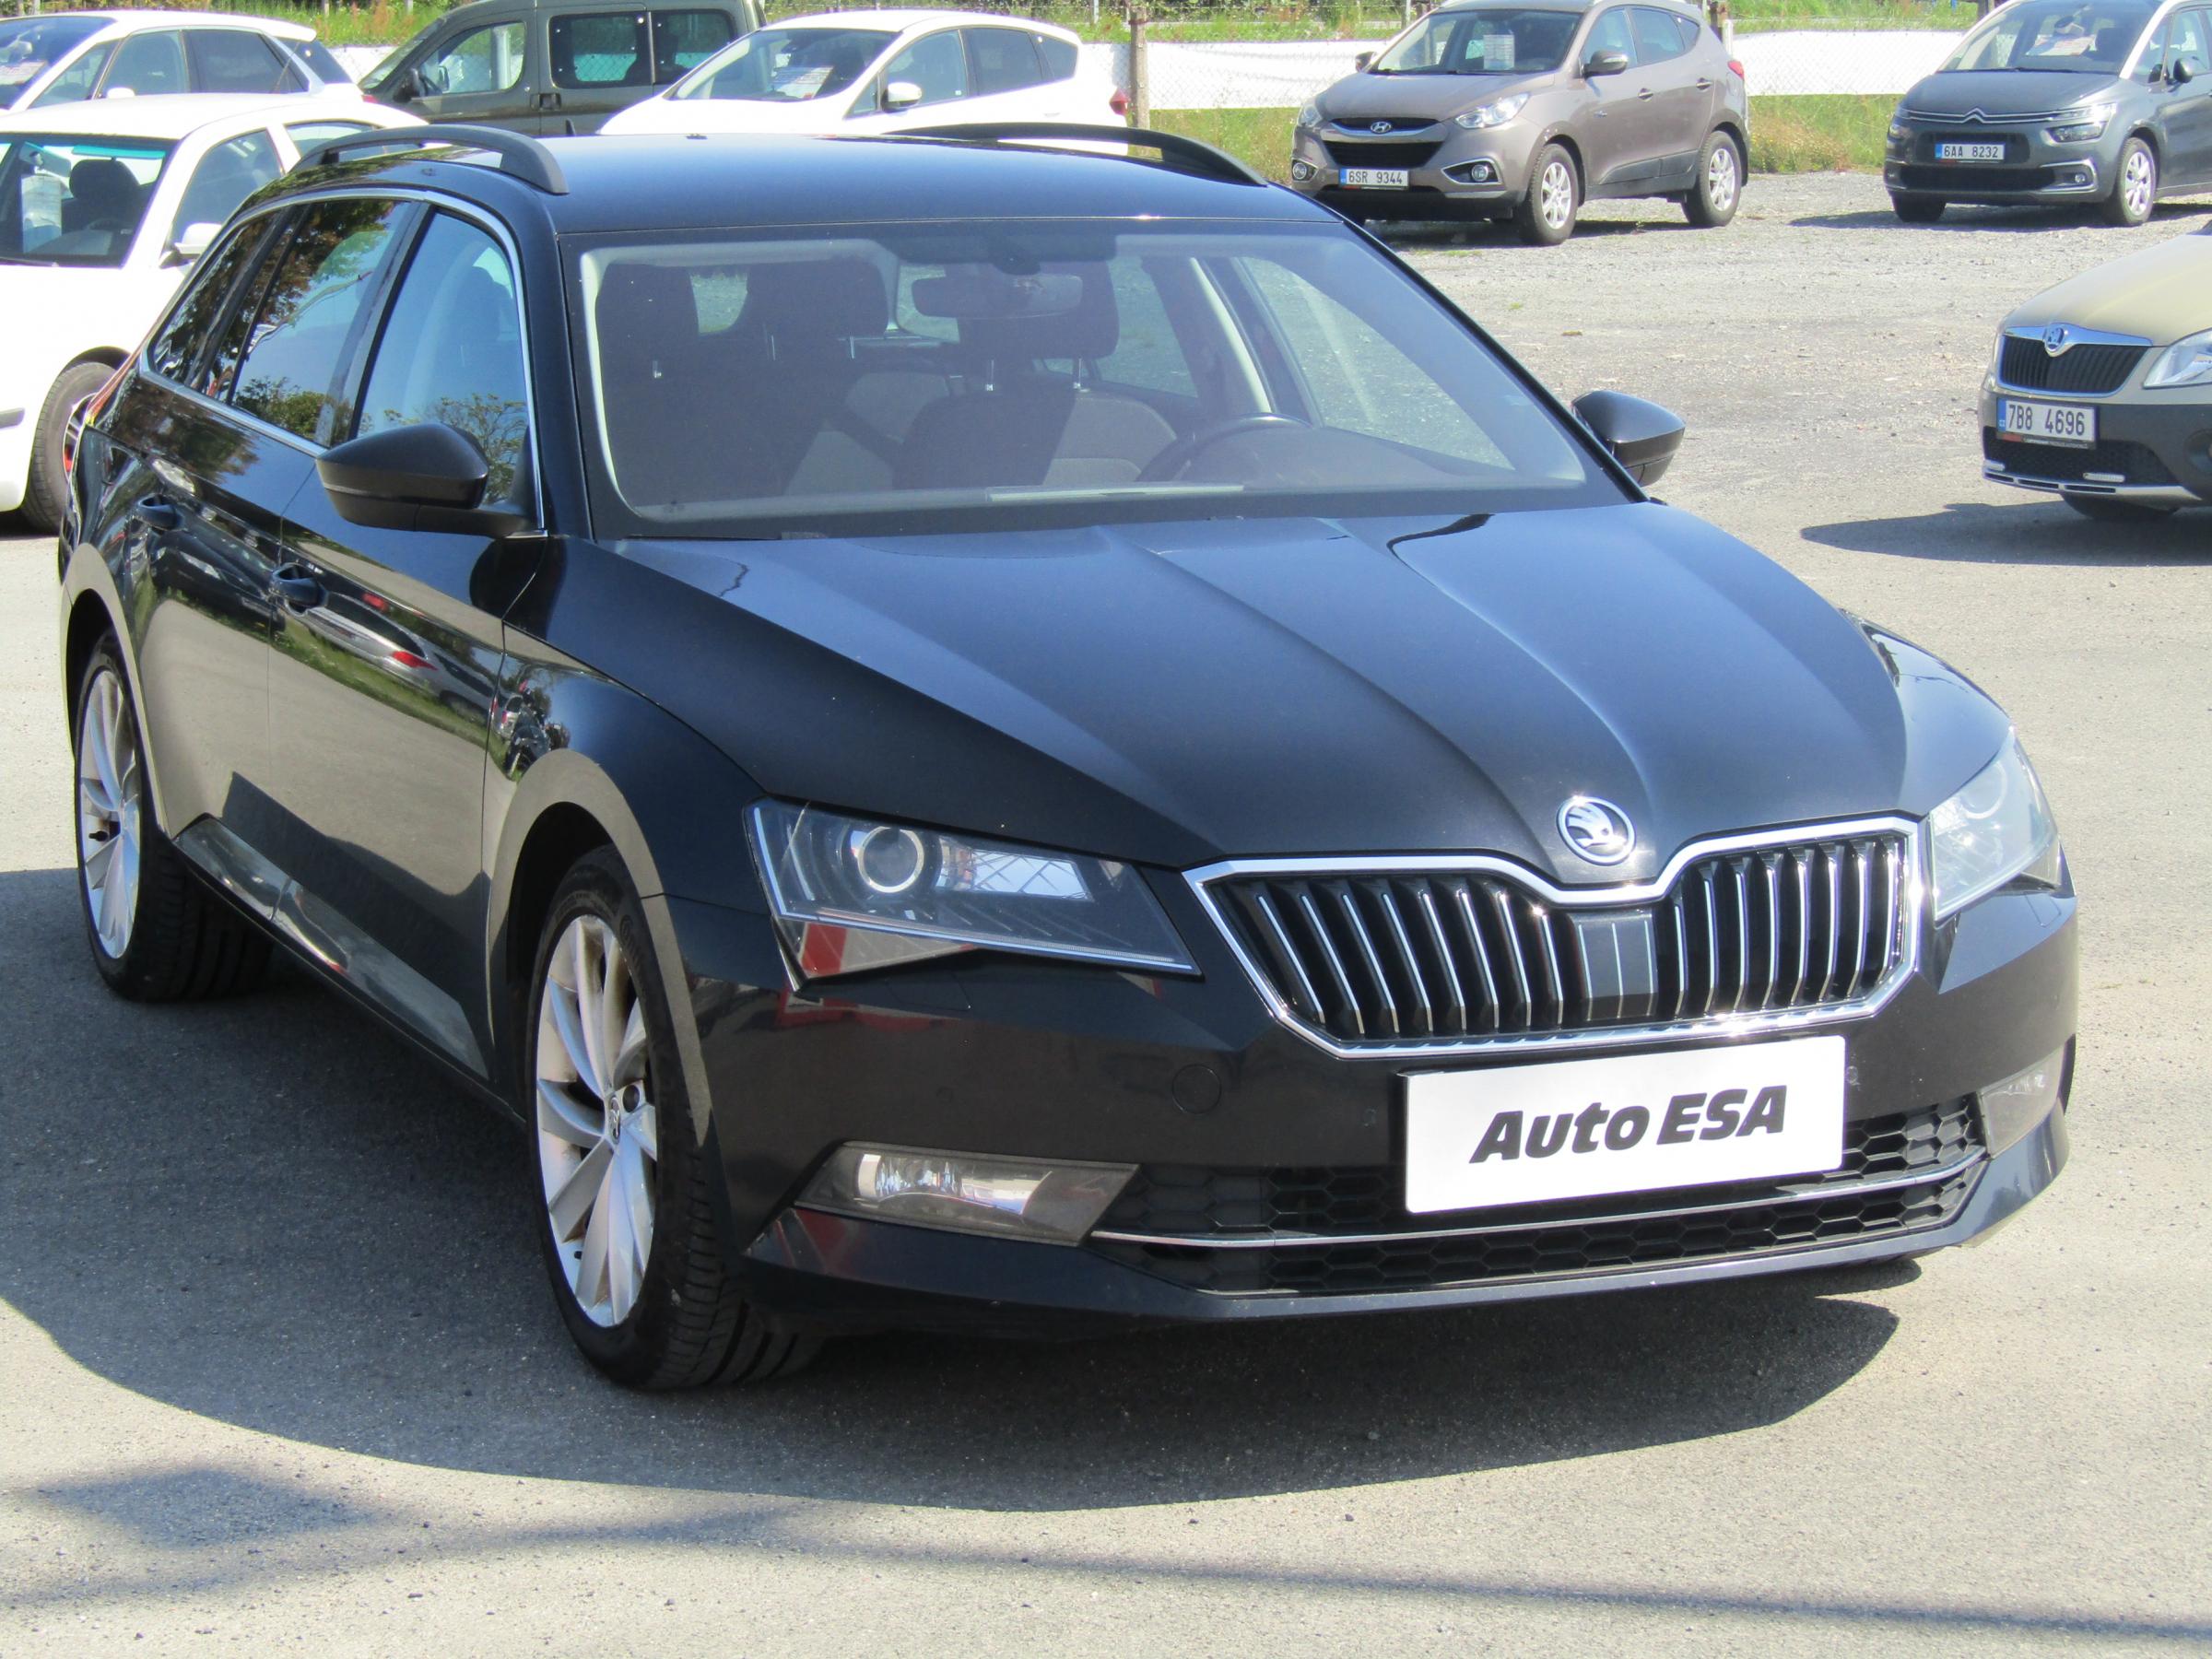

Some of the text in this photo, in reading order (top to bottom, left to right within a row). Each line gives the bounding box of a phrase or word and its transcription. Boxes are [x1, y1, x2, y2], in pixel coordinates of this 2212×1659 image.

[1944, 146, 1998, 159] 6AA 8232
[1348, 170, 1403, 184] 6SR 9344
[2044, 408, 2086, 436] 4696
[1468, 1084, 1788, 1165] Auto ESA
